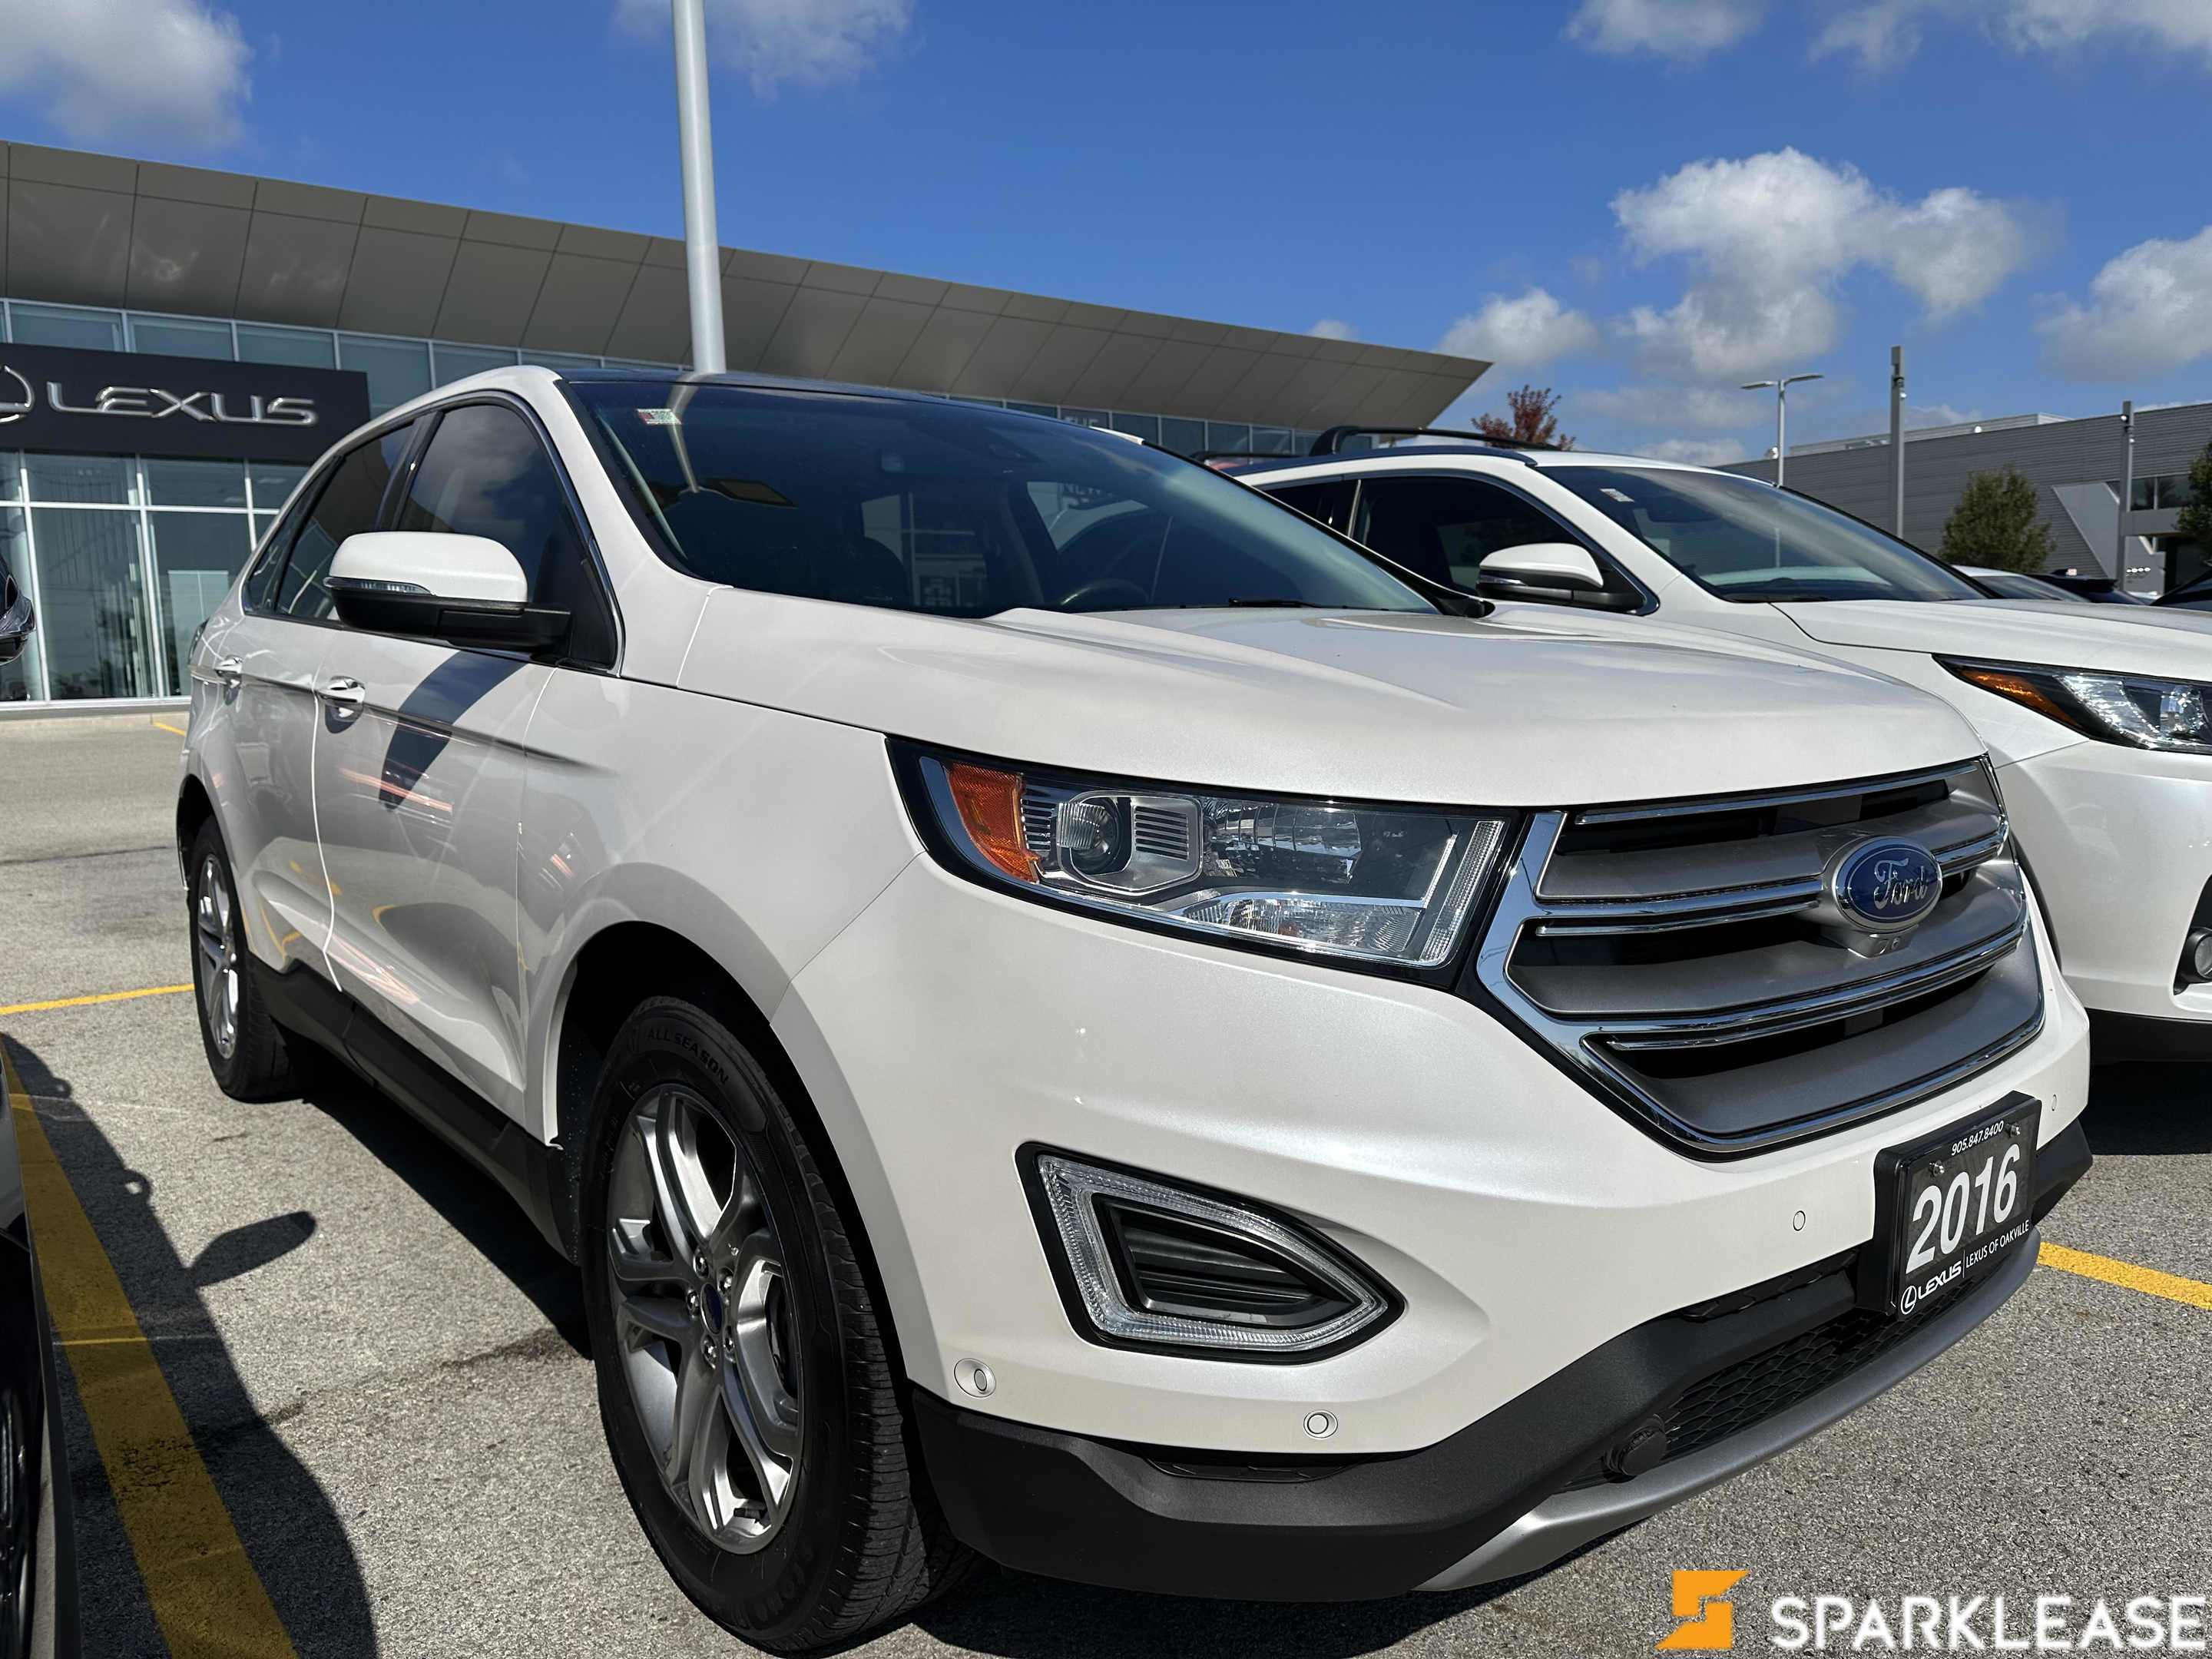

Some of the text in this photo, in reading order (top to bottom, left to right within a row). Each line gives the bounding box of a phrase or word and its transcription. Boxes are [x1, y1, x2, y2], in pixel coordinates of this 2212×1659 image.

[47, 382, 318, 426] LEXUS
[1874, 858, 1929, 909] Ford
[647, 1028, 730, 1084] ALL SEASON
[1951, 1120, 2004, 1156] 905.847.8400
[1906, 1144, 2020, 1274] 2016
[1917, 1219, 2029, 1300] LEXUS LEXUS OF OAKVILLE
